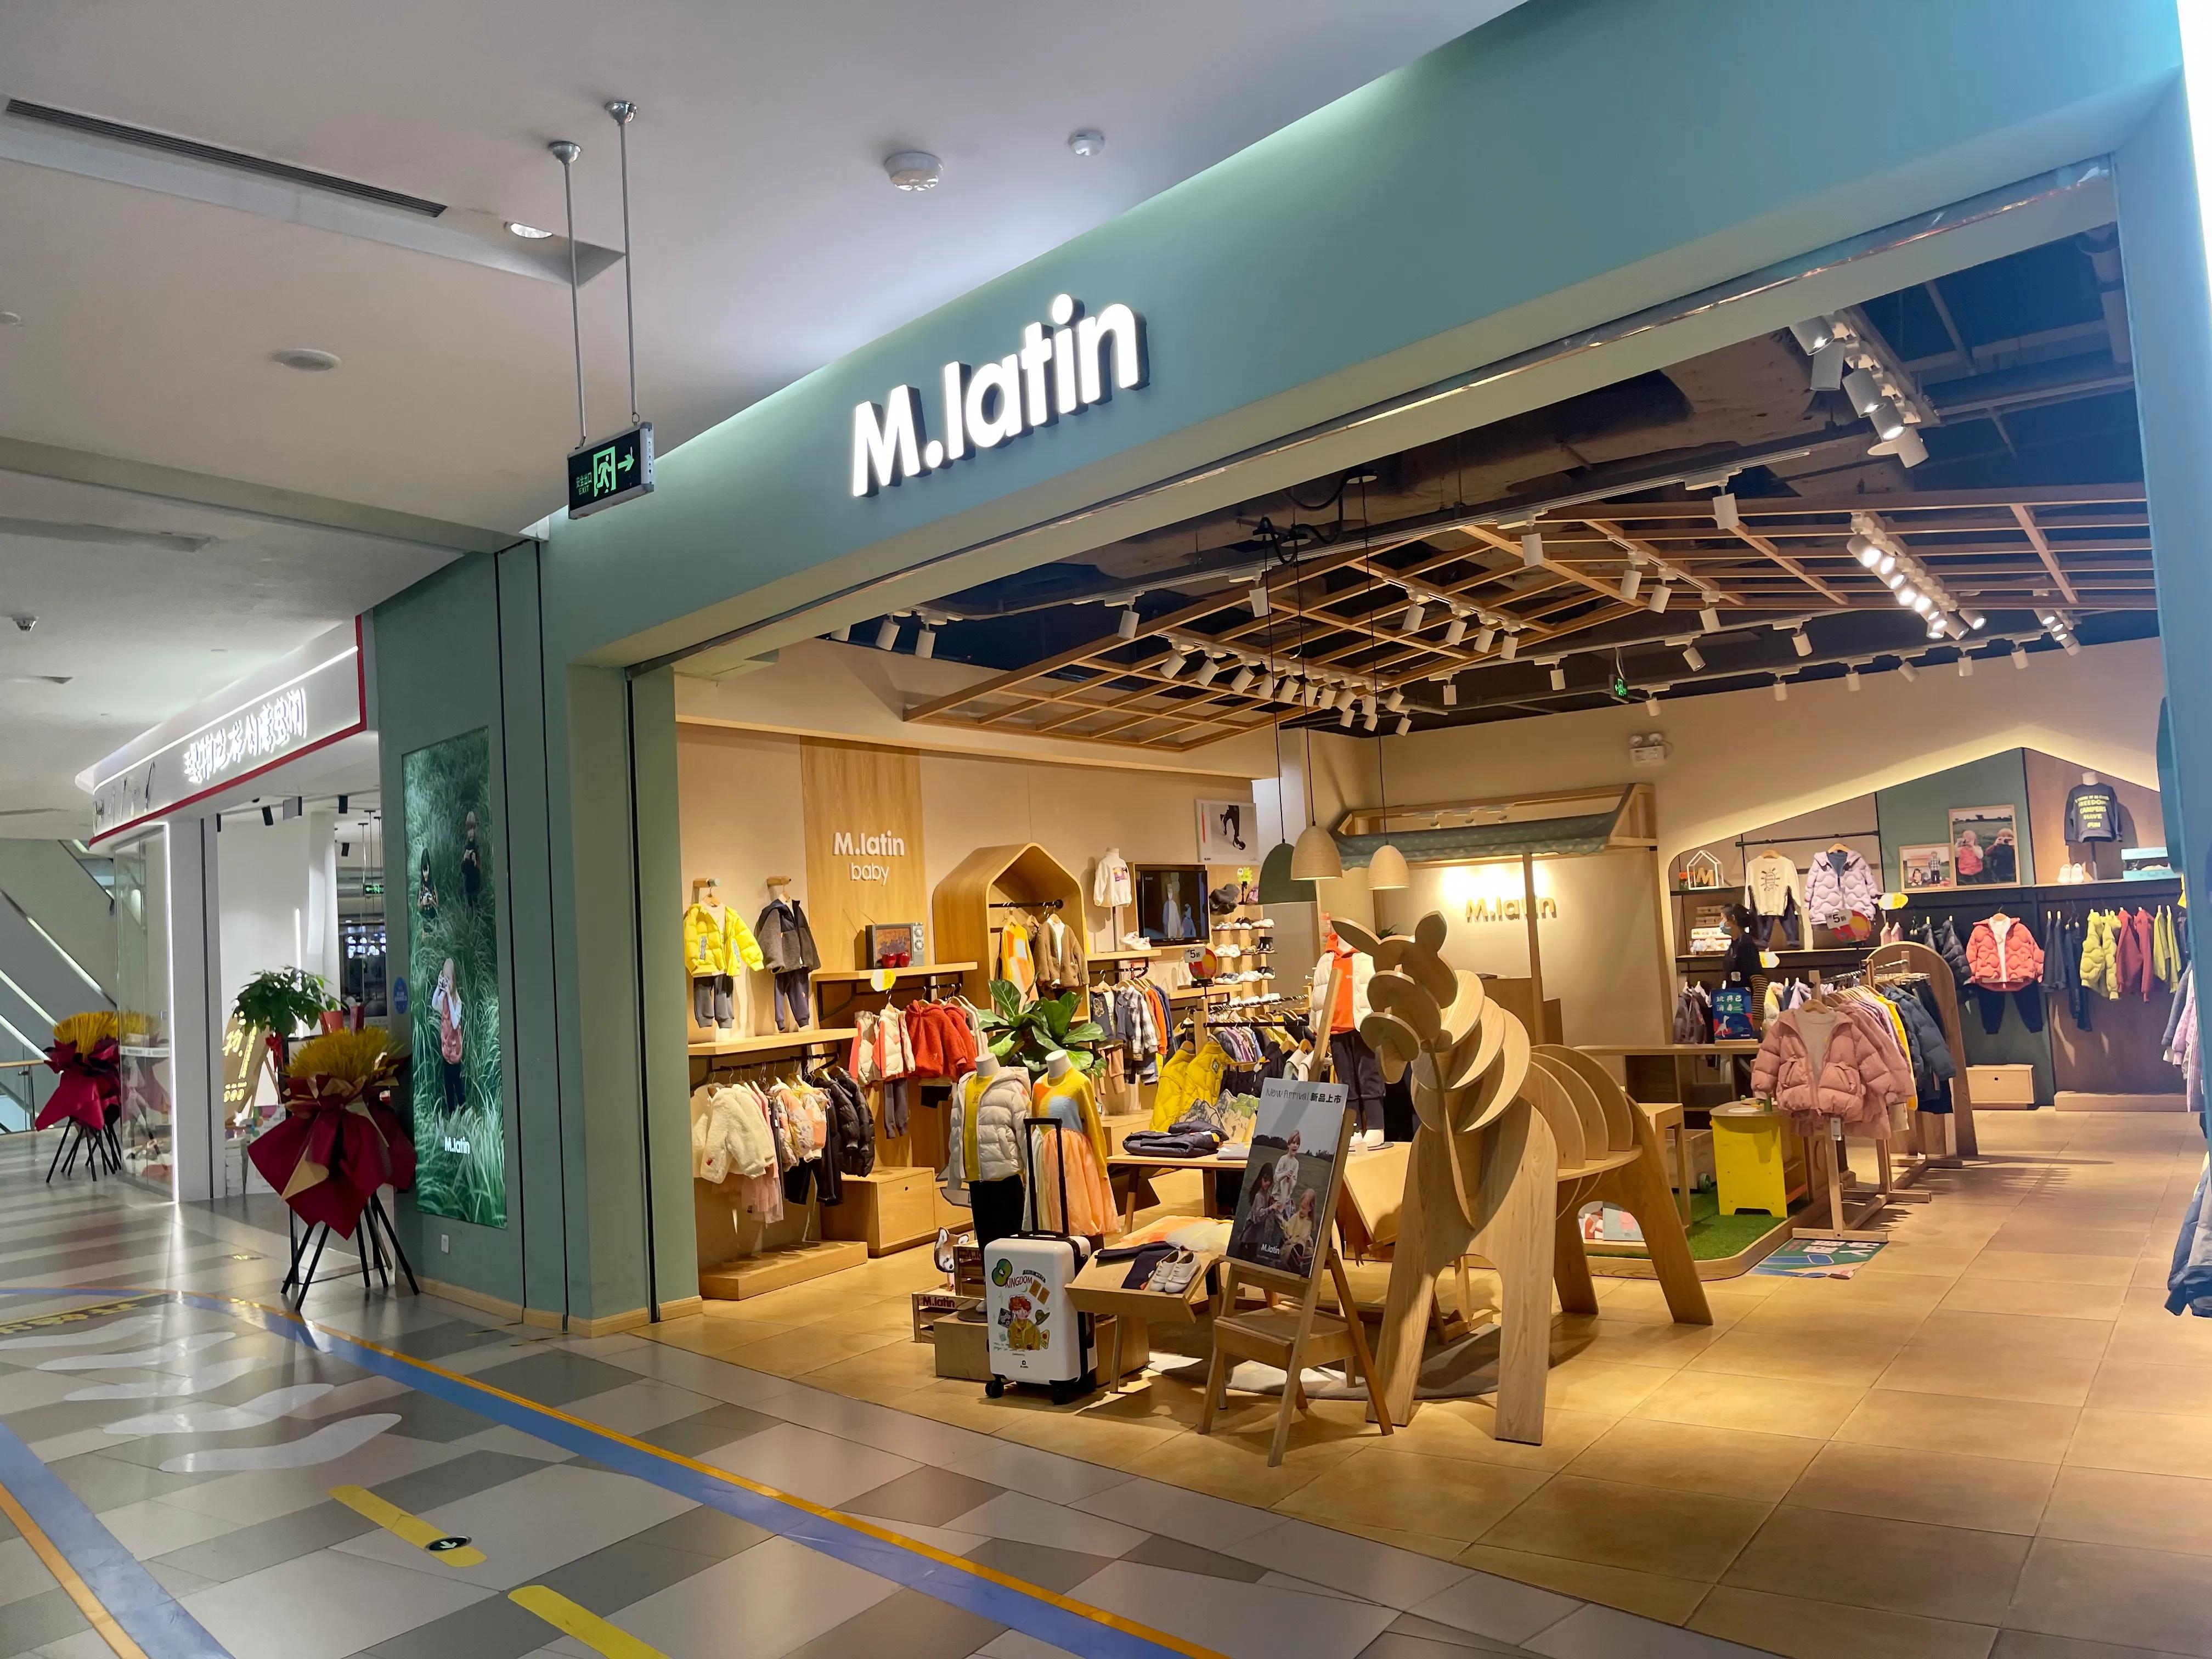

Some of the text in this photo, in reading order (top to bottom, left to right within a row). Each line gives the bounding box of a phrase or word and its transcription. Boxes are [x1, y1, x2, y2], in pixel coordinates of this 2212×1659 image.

[853, 294, 1142, 497] M.latin
[578, 484, 589, 495] EXIT
[833, 830, 904, 856] M.latin
[850, 862, 889, 886] baby
[1266, 1088, 1342, 1104] New Arrival 新品上市
[444, 1136, 470, 1154] M.latin
[923, 1296, 955, 1308] M.latin
